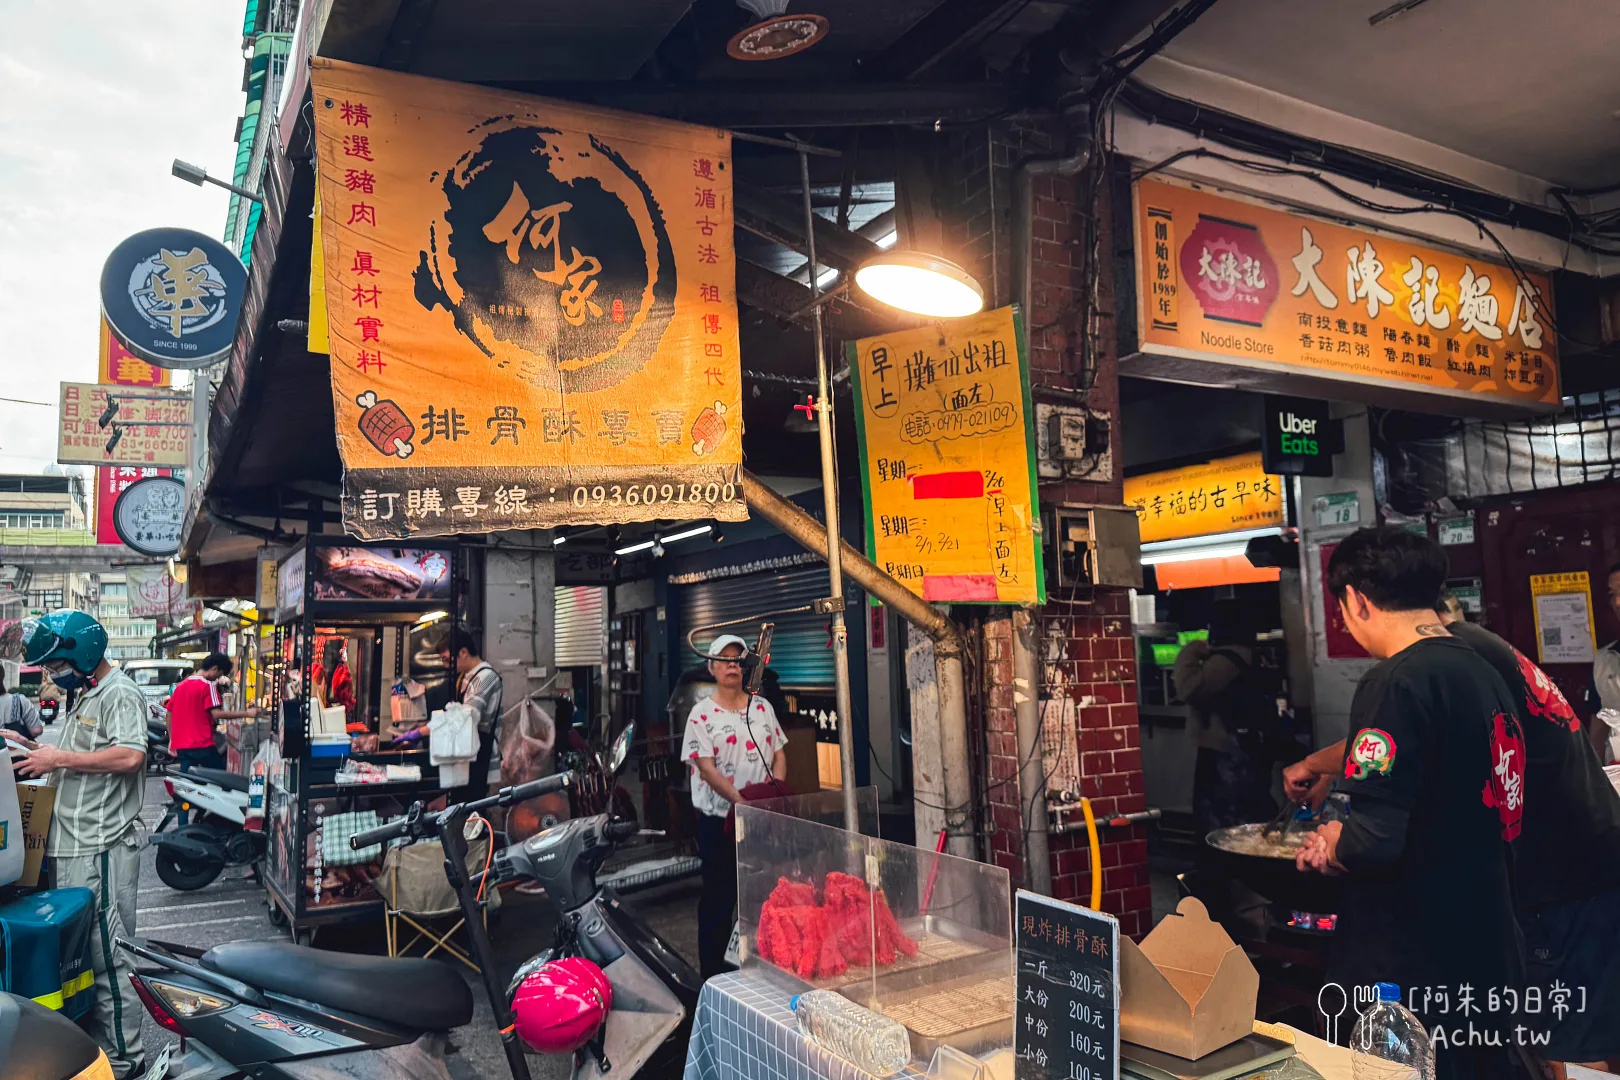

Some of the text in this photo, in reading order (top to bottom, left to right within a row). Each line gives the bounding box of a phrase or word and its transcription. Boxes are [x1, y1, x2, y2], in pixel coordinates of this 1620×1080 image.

[340, 100, 376, 227] 精選豬肉
[693, 159, 724, 387] 遵循古法 祖傳四代
[1198, 247, 1266, 289] 大陳記
[154, 340, 178, 349] SINCE
[1201, 331, 1274, 355] Noodle Store
[872, 347, 898, 410] 早上
[904, 339, 1011, 391] 攤位出租
[421, 404, 688, 446] 排骨酥專賣
[1279, 411, 1317, 435] Uber
[1281, 433, 1319, 455] Eats
[572, 481, 736, 509] 0936091800
[1335, 508, 1350, 523] 18
[1022, 914, 1109, 960] 現炸排骨酥
[1024, 959, 1105, 998] 一斤 320元
[1024, 984, 1105, 1029] 大份 200元
[1023, 1042, 1048, 1067] 小份
[1024, 1012, 1105, 1060] 中份 160元
